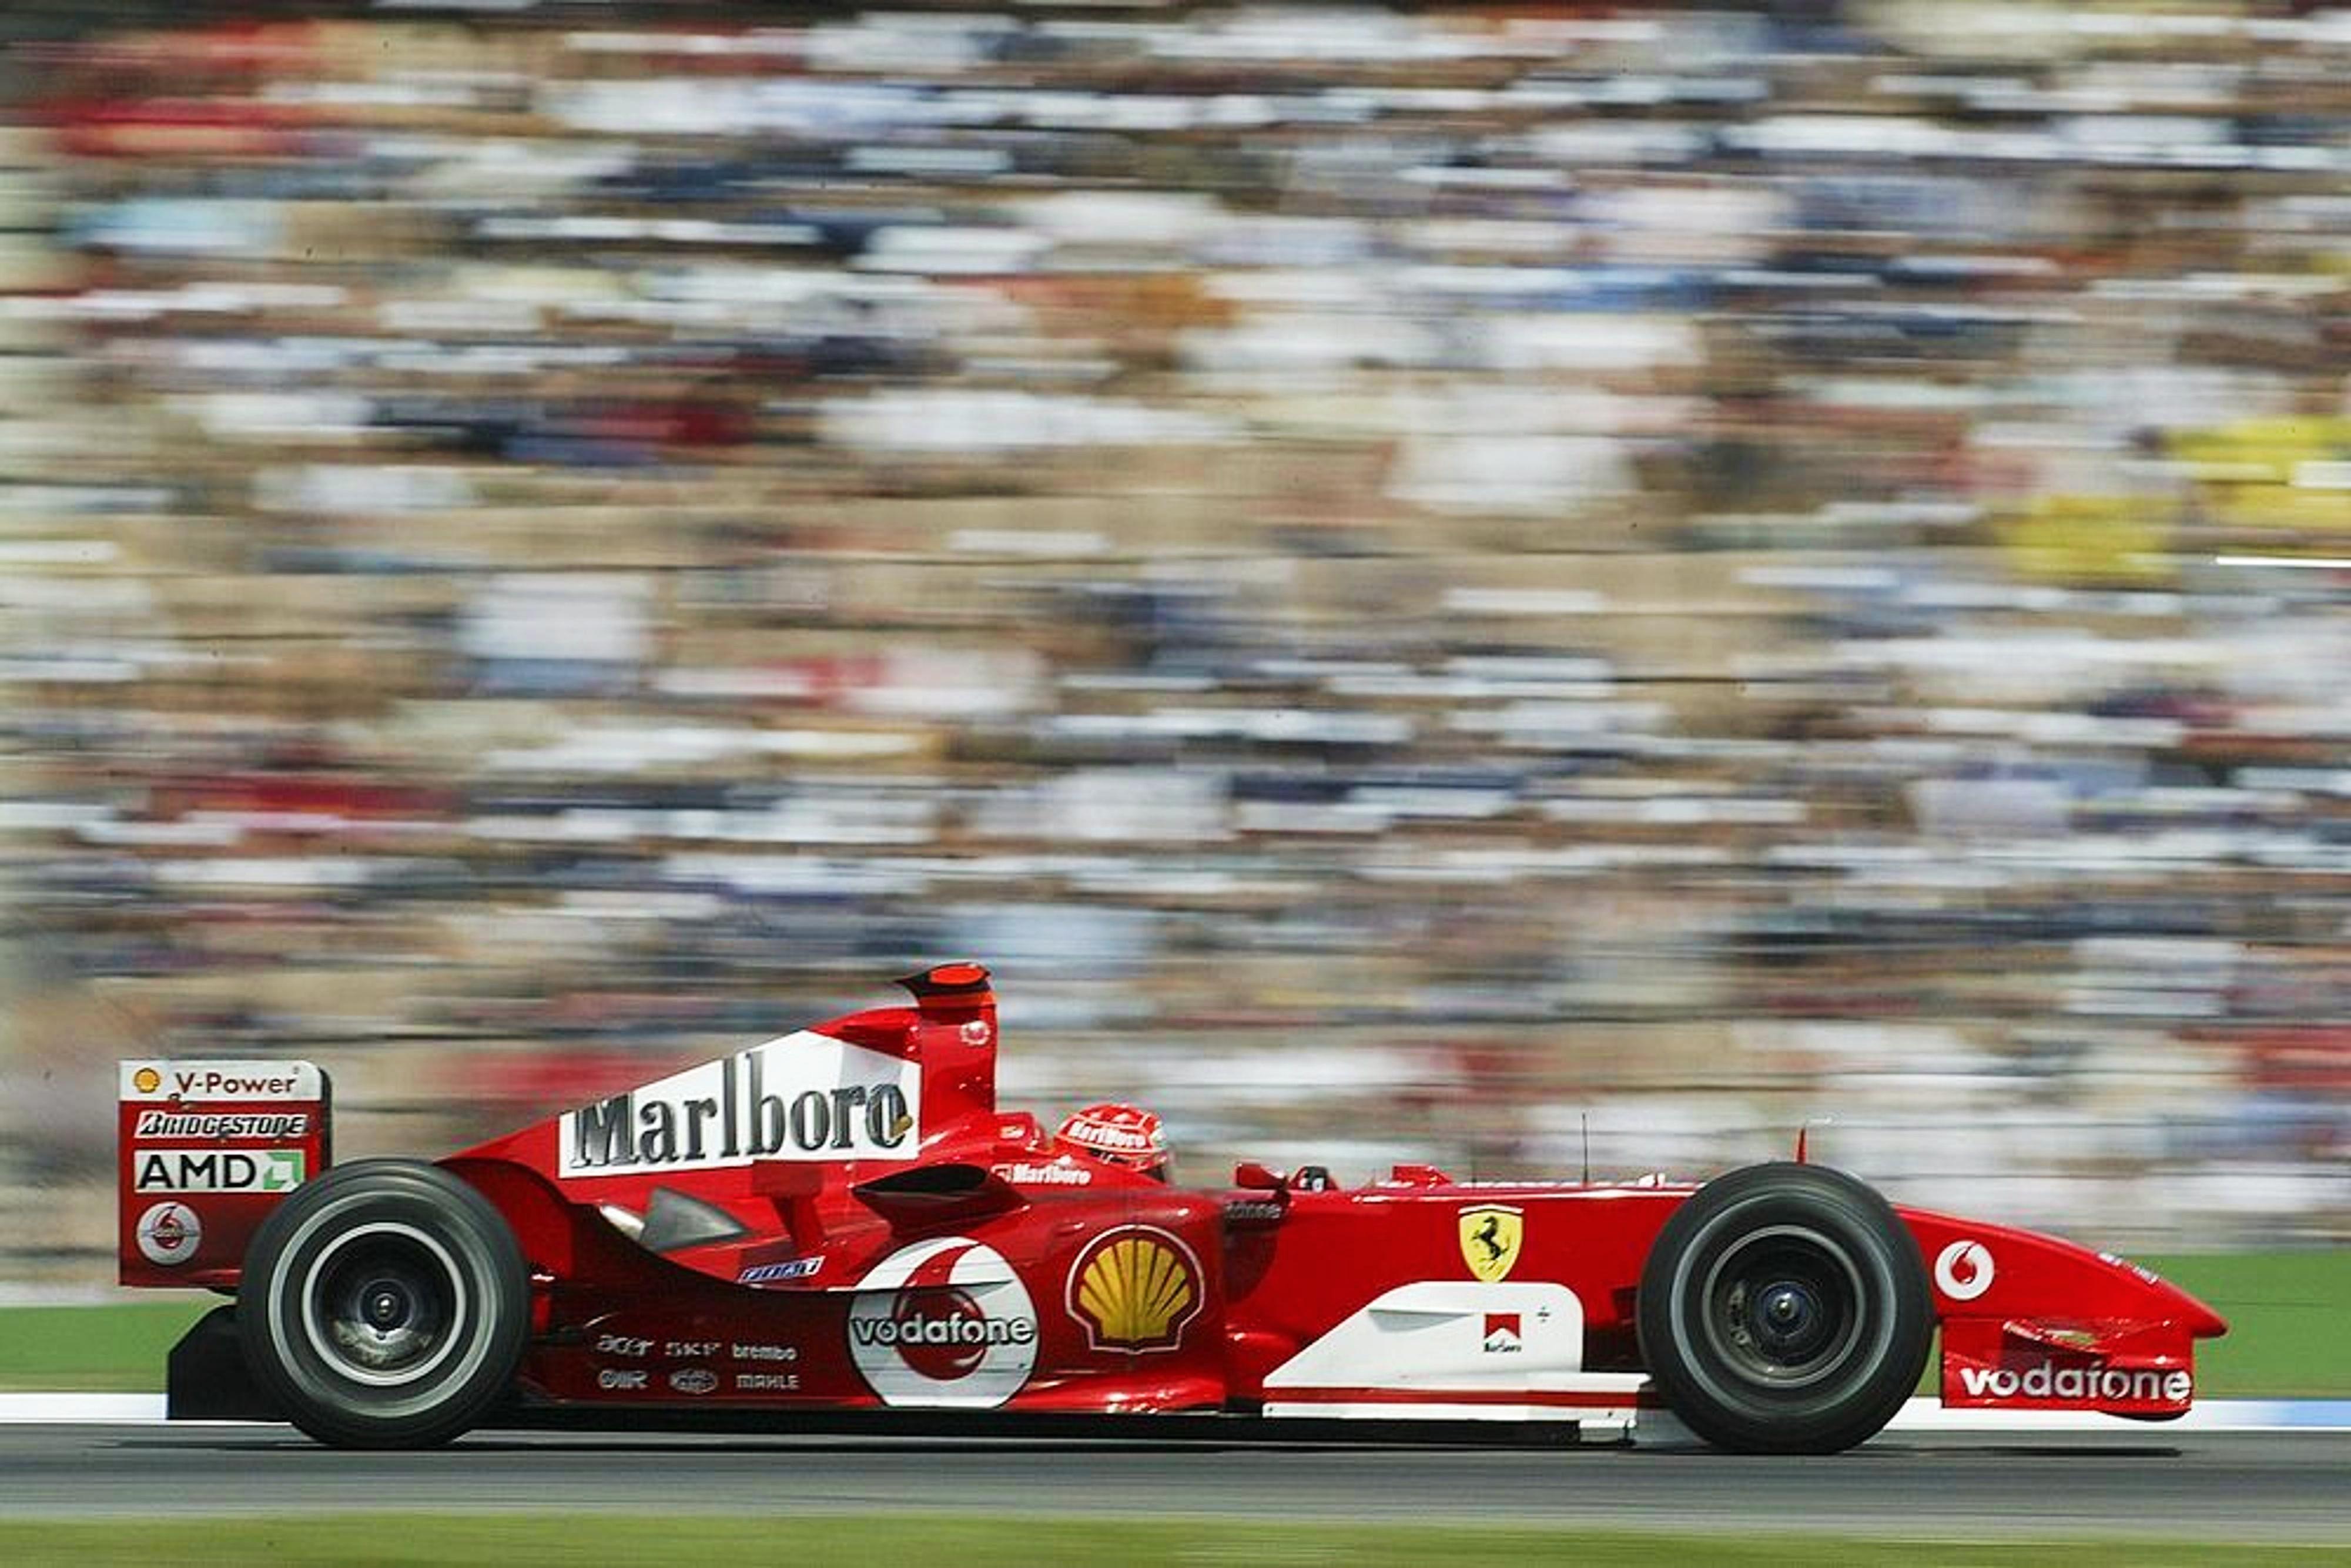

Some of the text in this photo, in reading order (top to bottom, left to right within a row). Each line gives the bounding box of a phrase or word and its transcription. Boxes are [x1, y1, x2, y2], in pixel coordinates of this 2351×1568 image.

[176, 1072, 297, 1094] V-Power
[570, 1052, 908, 1169] Marlboro
[140, 1114, 307, 1136] BRIDGESTONE
[1067, 1120, 1146, 1147] Marlboro
[137, 1154, 257, 1189] AMD
[1012, 1163, 1091, 1184] Marlboro
[850, 1311, 1037, 1346] vodafone
[665, 1341, 722, 1356] SKF
[736, 1375, 800, 1389] MAHLE
[1960, 1359, 2192, 1401] vodafone
